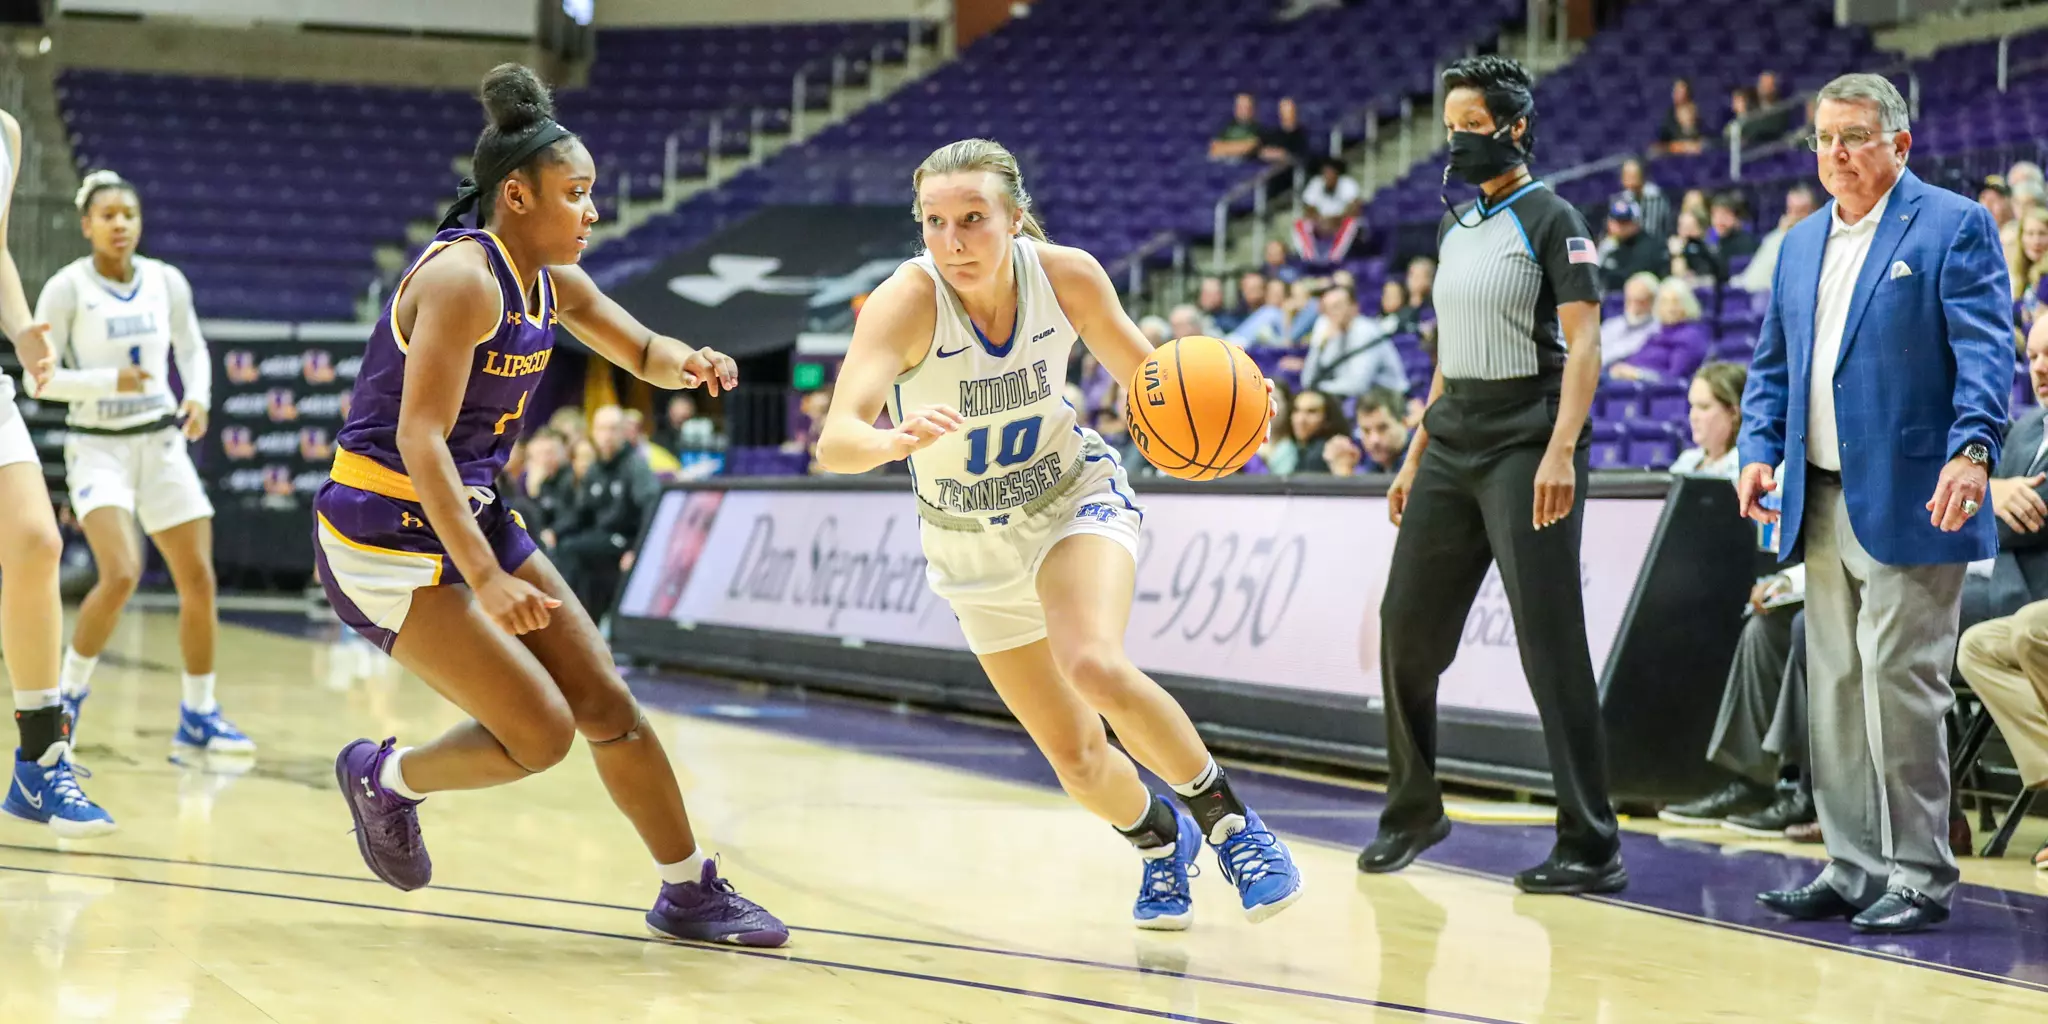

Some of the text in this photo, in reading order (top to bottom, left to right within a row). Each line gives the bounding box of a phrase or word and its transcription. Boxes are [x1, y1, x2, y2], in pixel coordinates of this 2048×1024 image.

[959, 360, 1051, 417] MIDDLE
[963, 415, 1045, 476] 10
[935, 452, 1062, 513] TENNESSEE
[727, 513, 798, 602] Dan
